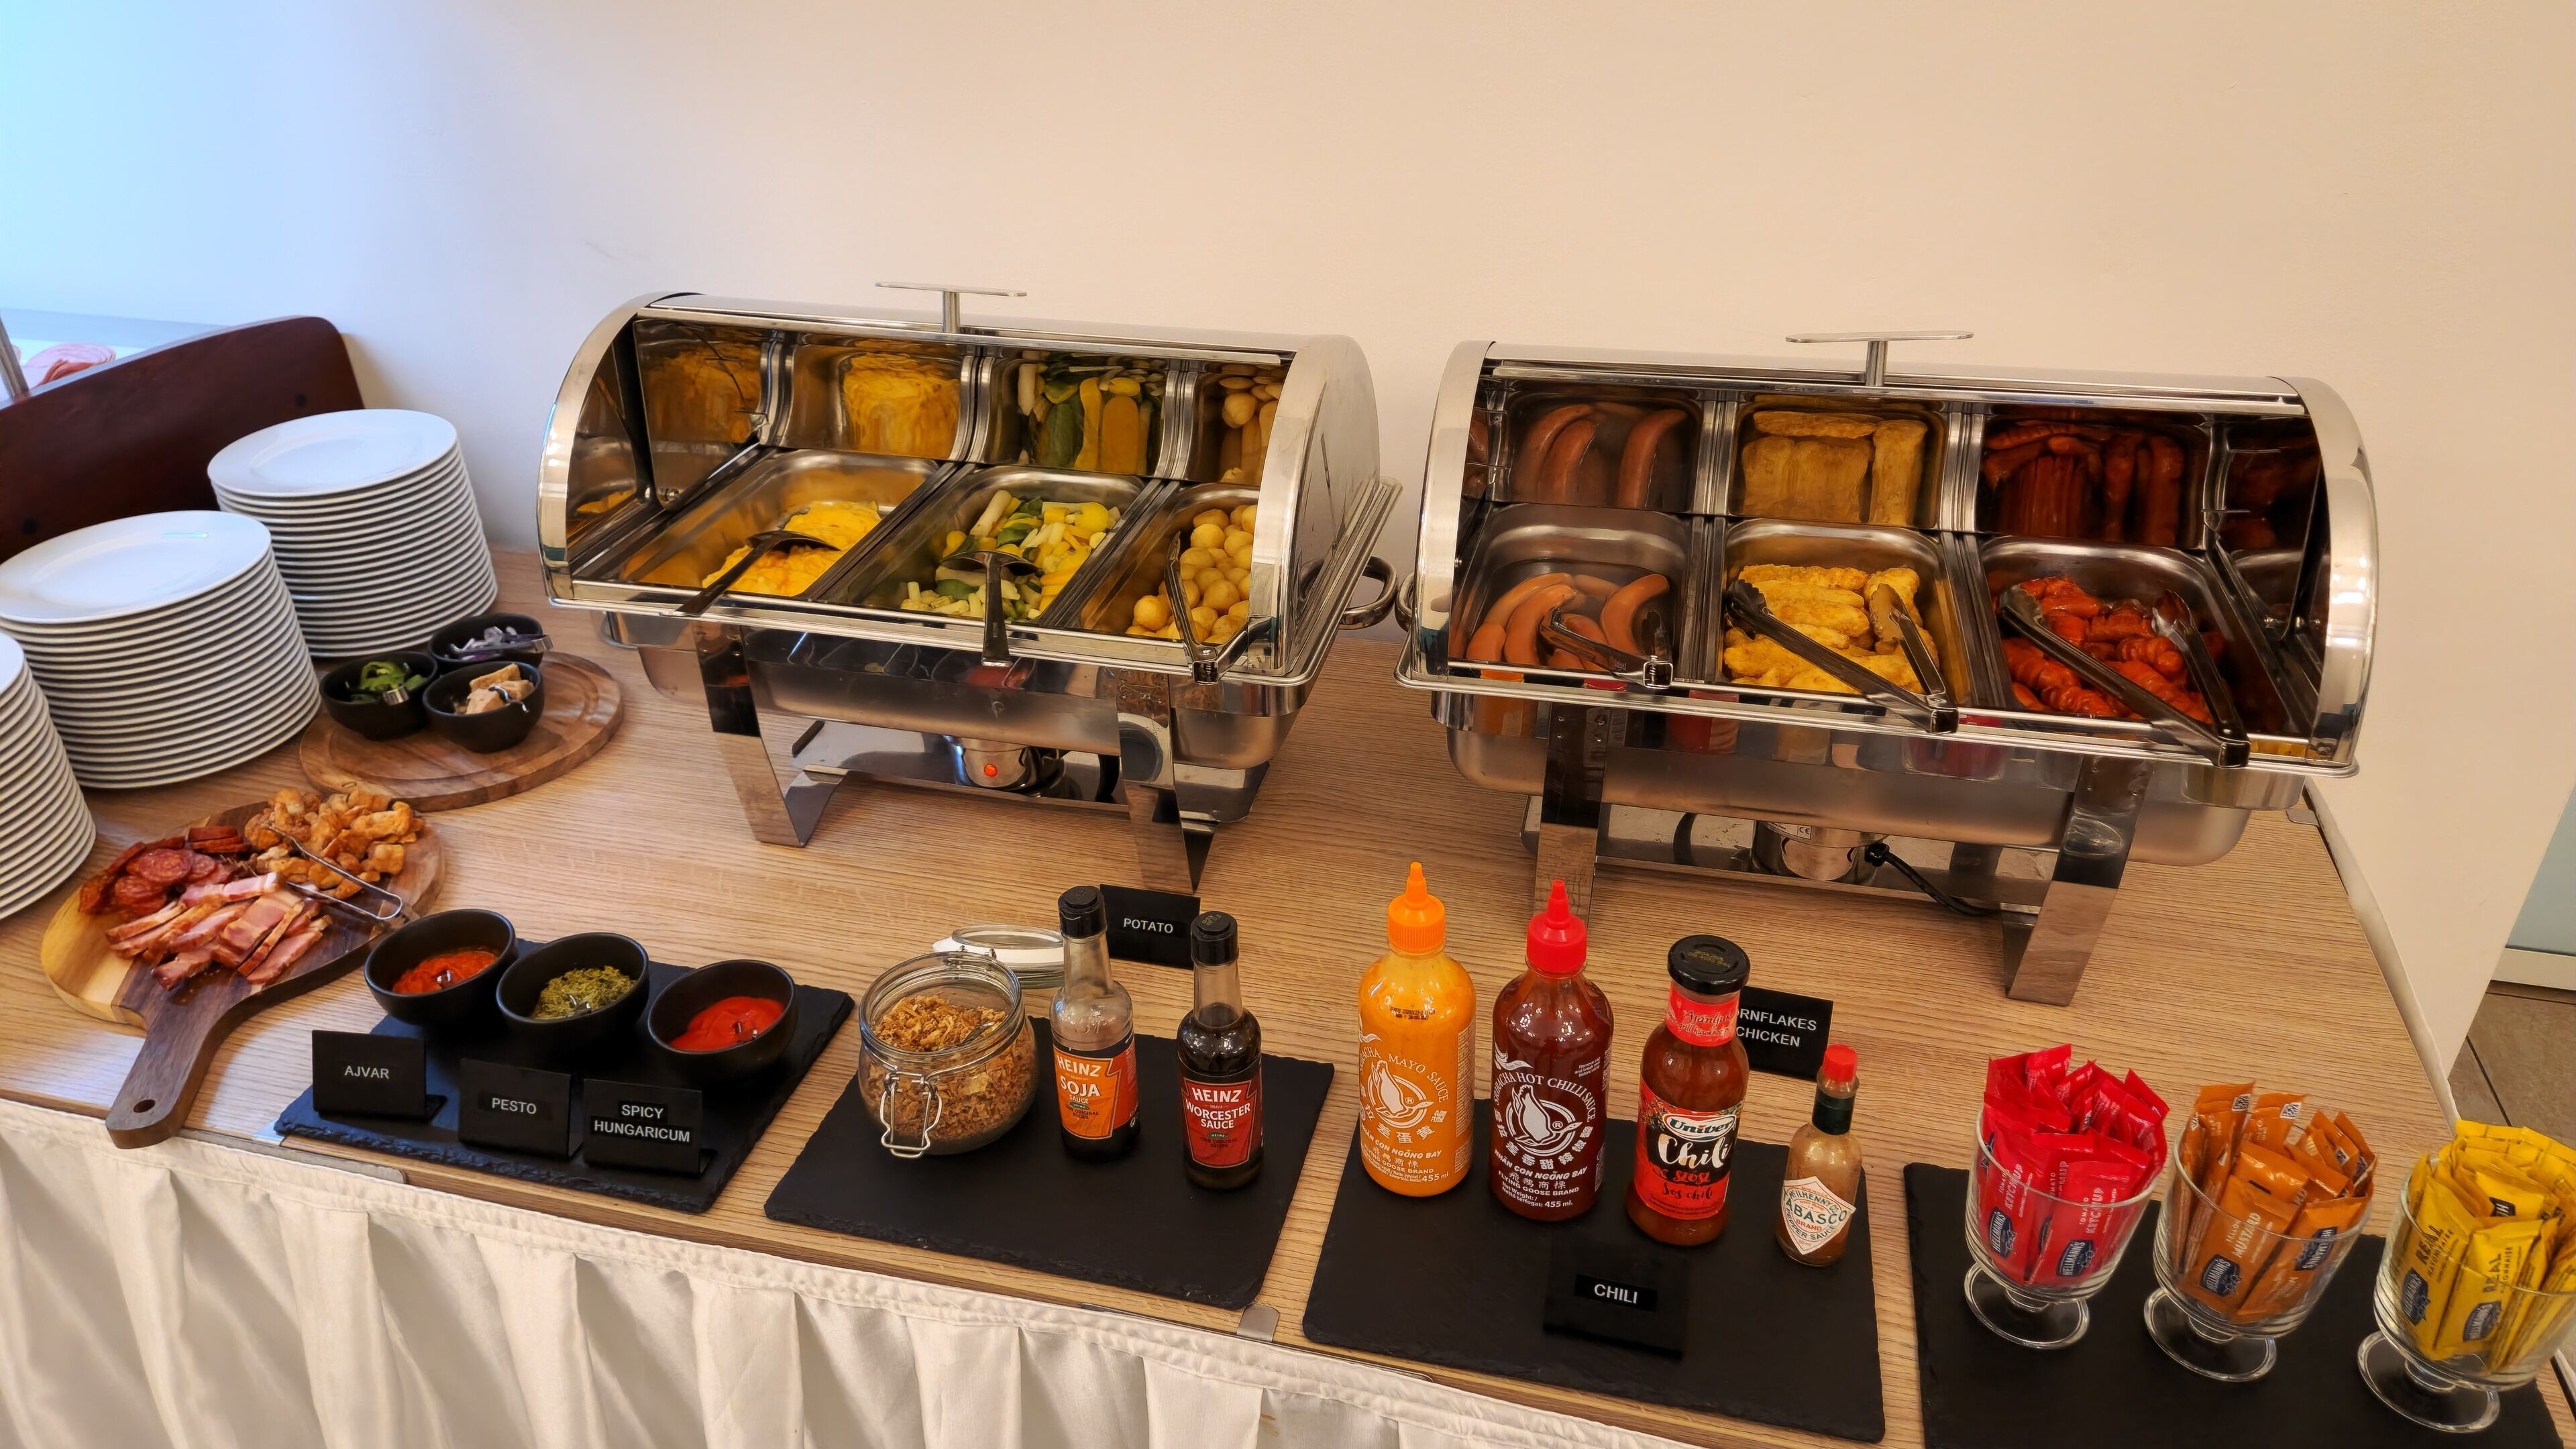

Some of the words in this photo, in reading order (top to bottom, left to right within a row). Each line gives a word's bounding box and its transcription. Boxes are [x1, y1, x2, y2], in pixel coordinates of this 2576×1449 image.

[1123, 918, 1173, 933] POTATO
[1737, 1008, 1817, 1031] RNFLAKES
[1736, 1026, 1801, 1047] CHICKEN
[344, 1065, 390, 1080] AJVAR
[1057, 1055, 1101, 1077] HEINZ
[1060, 1075, 1101, 1097] SOJA
[1389, 1053, 1426, 1073] MAYO
[1427, 1071, 1449, 1102] SAUCE
[1069, 1094, 1089, 1104] SAUCE
[1191, 1087, 1242, 1102] HEINZ
[1516, 1072, 1544, 1085] HOT
[1547, 1077, 1587, 1097] CHILLI
[1582, 1091, 1596, 1122] SAUCE
[492, 1097, 537, 1115] PESTO
[621, 1104, 664, 1120] SPICY
[1186, 1098, 1250, 1120] WORCESTER
[594, 1120, 690, 1143] HUNGARICUM
[1201, 1119, 1234, 1129] SAUCE
[1670, 1118, 1733, 1134] Univer
[1375, 1140, 1390, 1152] CON
[1426, 1150, 1442, 1159] BAY
[1658, 1134, 1732, 1169] Chili
[1382, 1161, 1405, 1173] GOOSE
[1514, 1166, 1533, 1177] CON
[1572, 1166, 1588, 1177] BAY
[1421, 1173, 1439, 1182] 455
[1498, 1170, 1520, 1189] FLYING
[1523, 1186, 1550, 1196] GOOSE
[1553, 1187, 1579, 1196] BRAND
[1502, 1181, 1511, 1190] Net
[1786, 1208, 1807, 1238] PEPPER
[1810, 1225, 1837, 1240] SAUCE
[1796, 1219, 1822, 1231] BRAND
[1992, 1211, 2006, 1252] HELLMANN'S
[2063, 1241, 2086, 1276] HELLMANN'S
[2206, 1258, 2231, 1291] HELLMANN'S
[1594, 1284, 1638, 1304] CHILI
